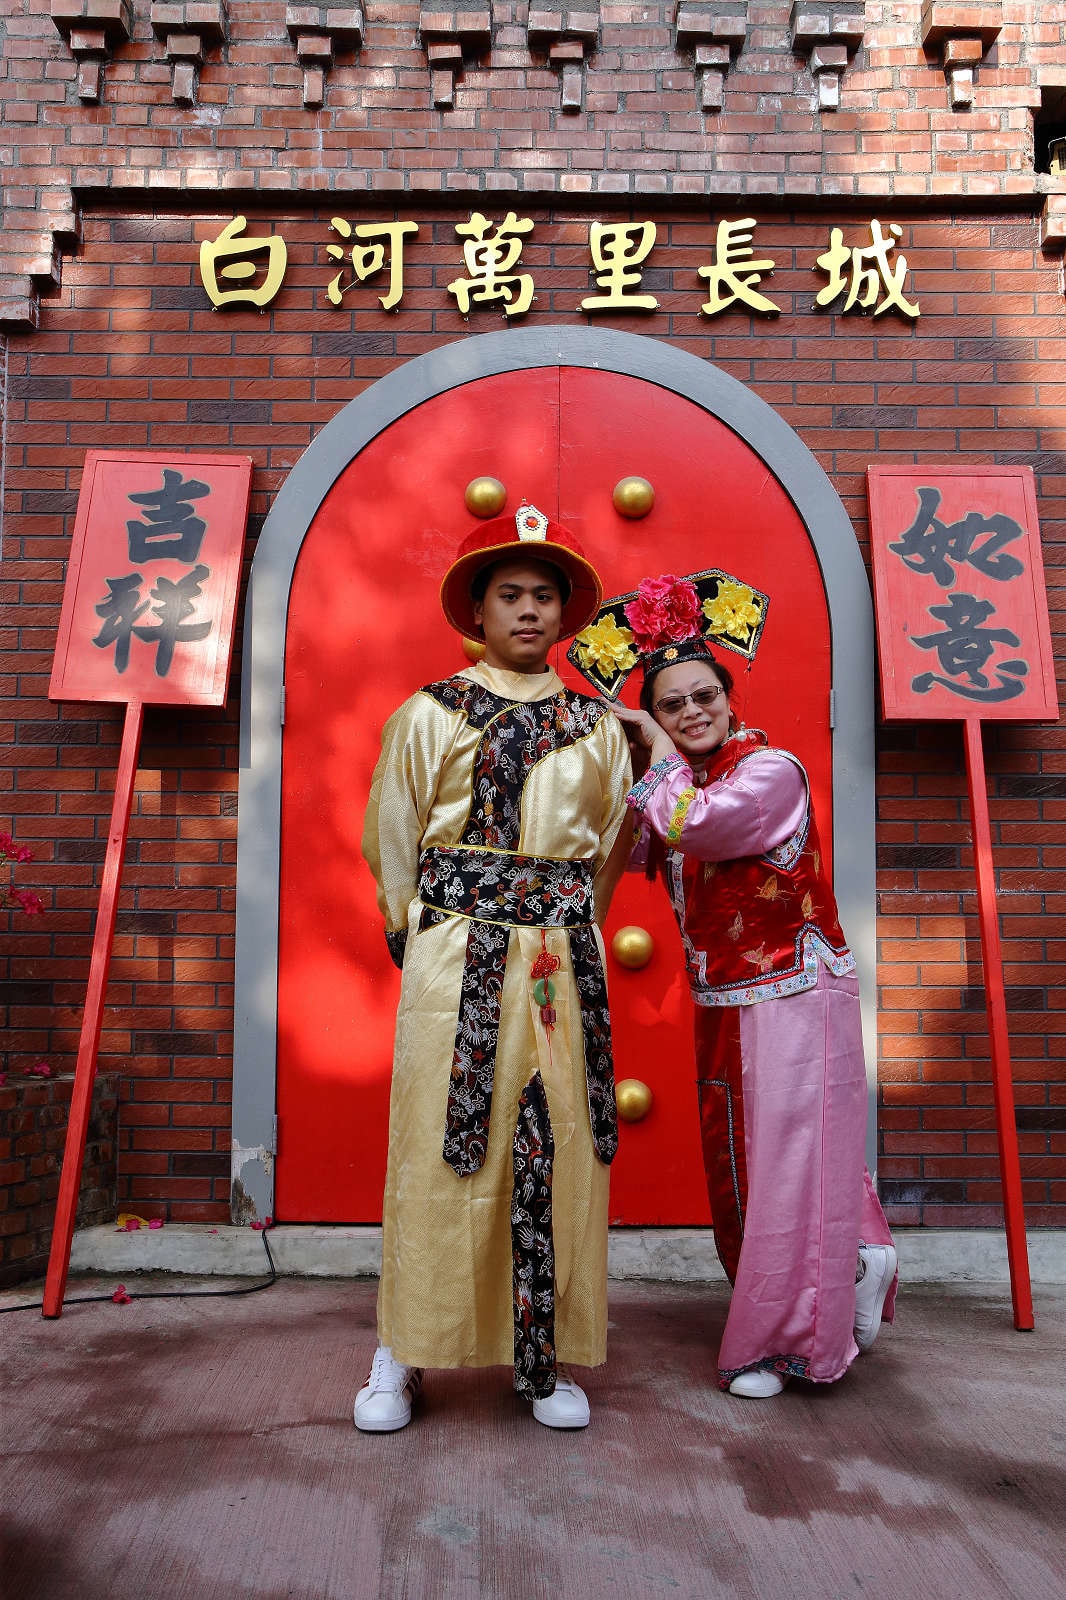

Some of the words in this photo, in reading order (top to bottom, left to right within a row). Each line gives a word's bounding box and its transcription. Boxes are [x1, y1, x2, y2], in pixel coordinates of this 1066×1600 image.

[199, 212, 922, 318] 白河萬里長城
[91, 468, 213, 677] 吉祥
[887, 486, 1029, 703] 如意
